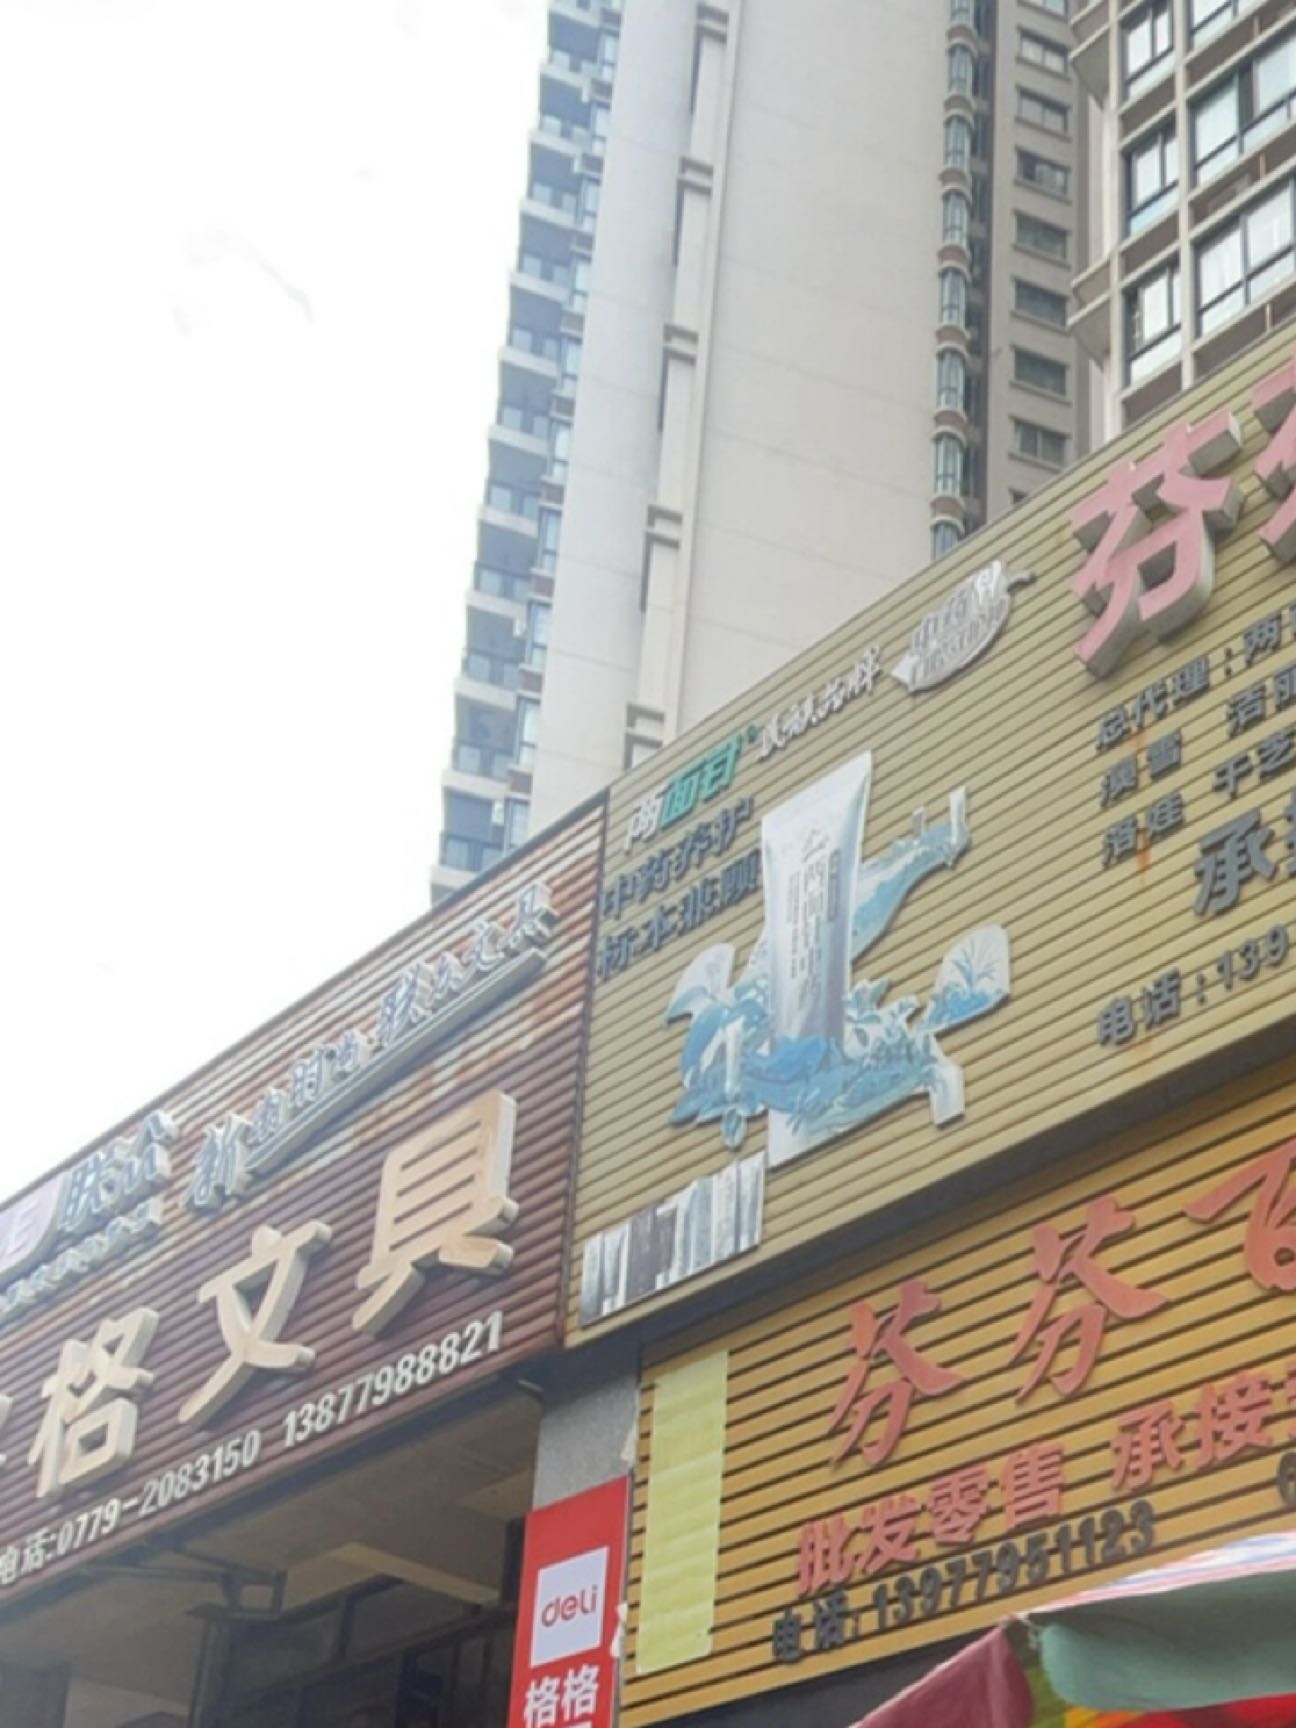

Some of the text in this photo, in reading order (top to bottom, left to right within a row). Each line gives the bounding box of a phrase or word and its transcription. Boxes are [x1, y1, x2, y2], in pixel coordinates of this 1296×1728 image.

[624, 735, 743, 855] 两面针
[0, 1089, 520, 1498] 格文具
[283, 1310, 504, 1452] 13877988821
[771, 1501, 1156, 1665] 电话:13977951123
[797, 1442, 1066, 1595] 批发零售
[541, 1585, 598, 1628] deli
